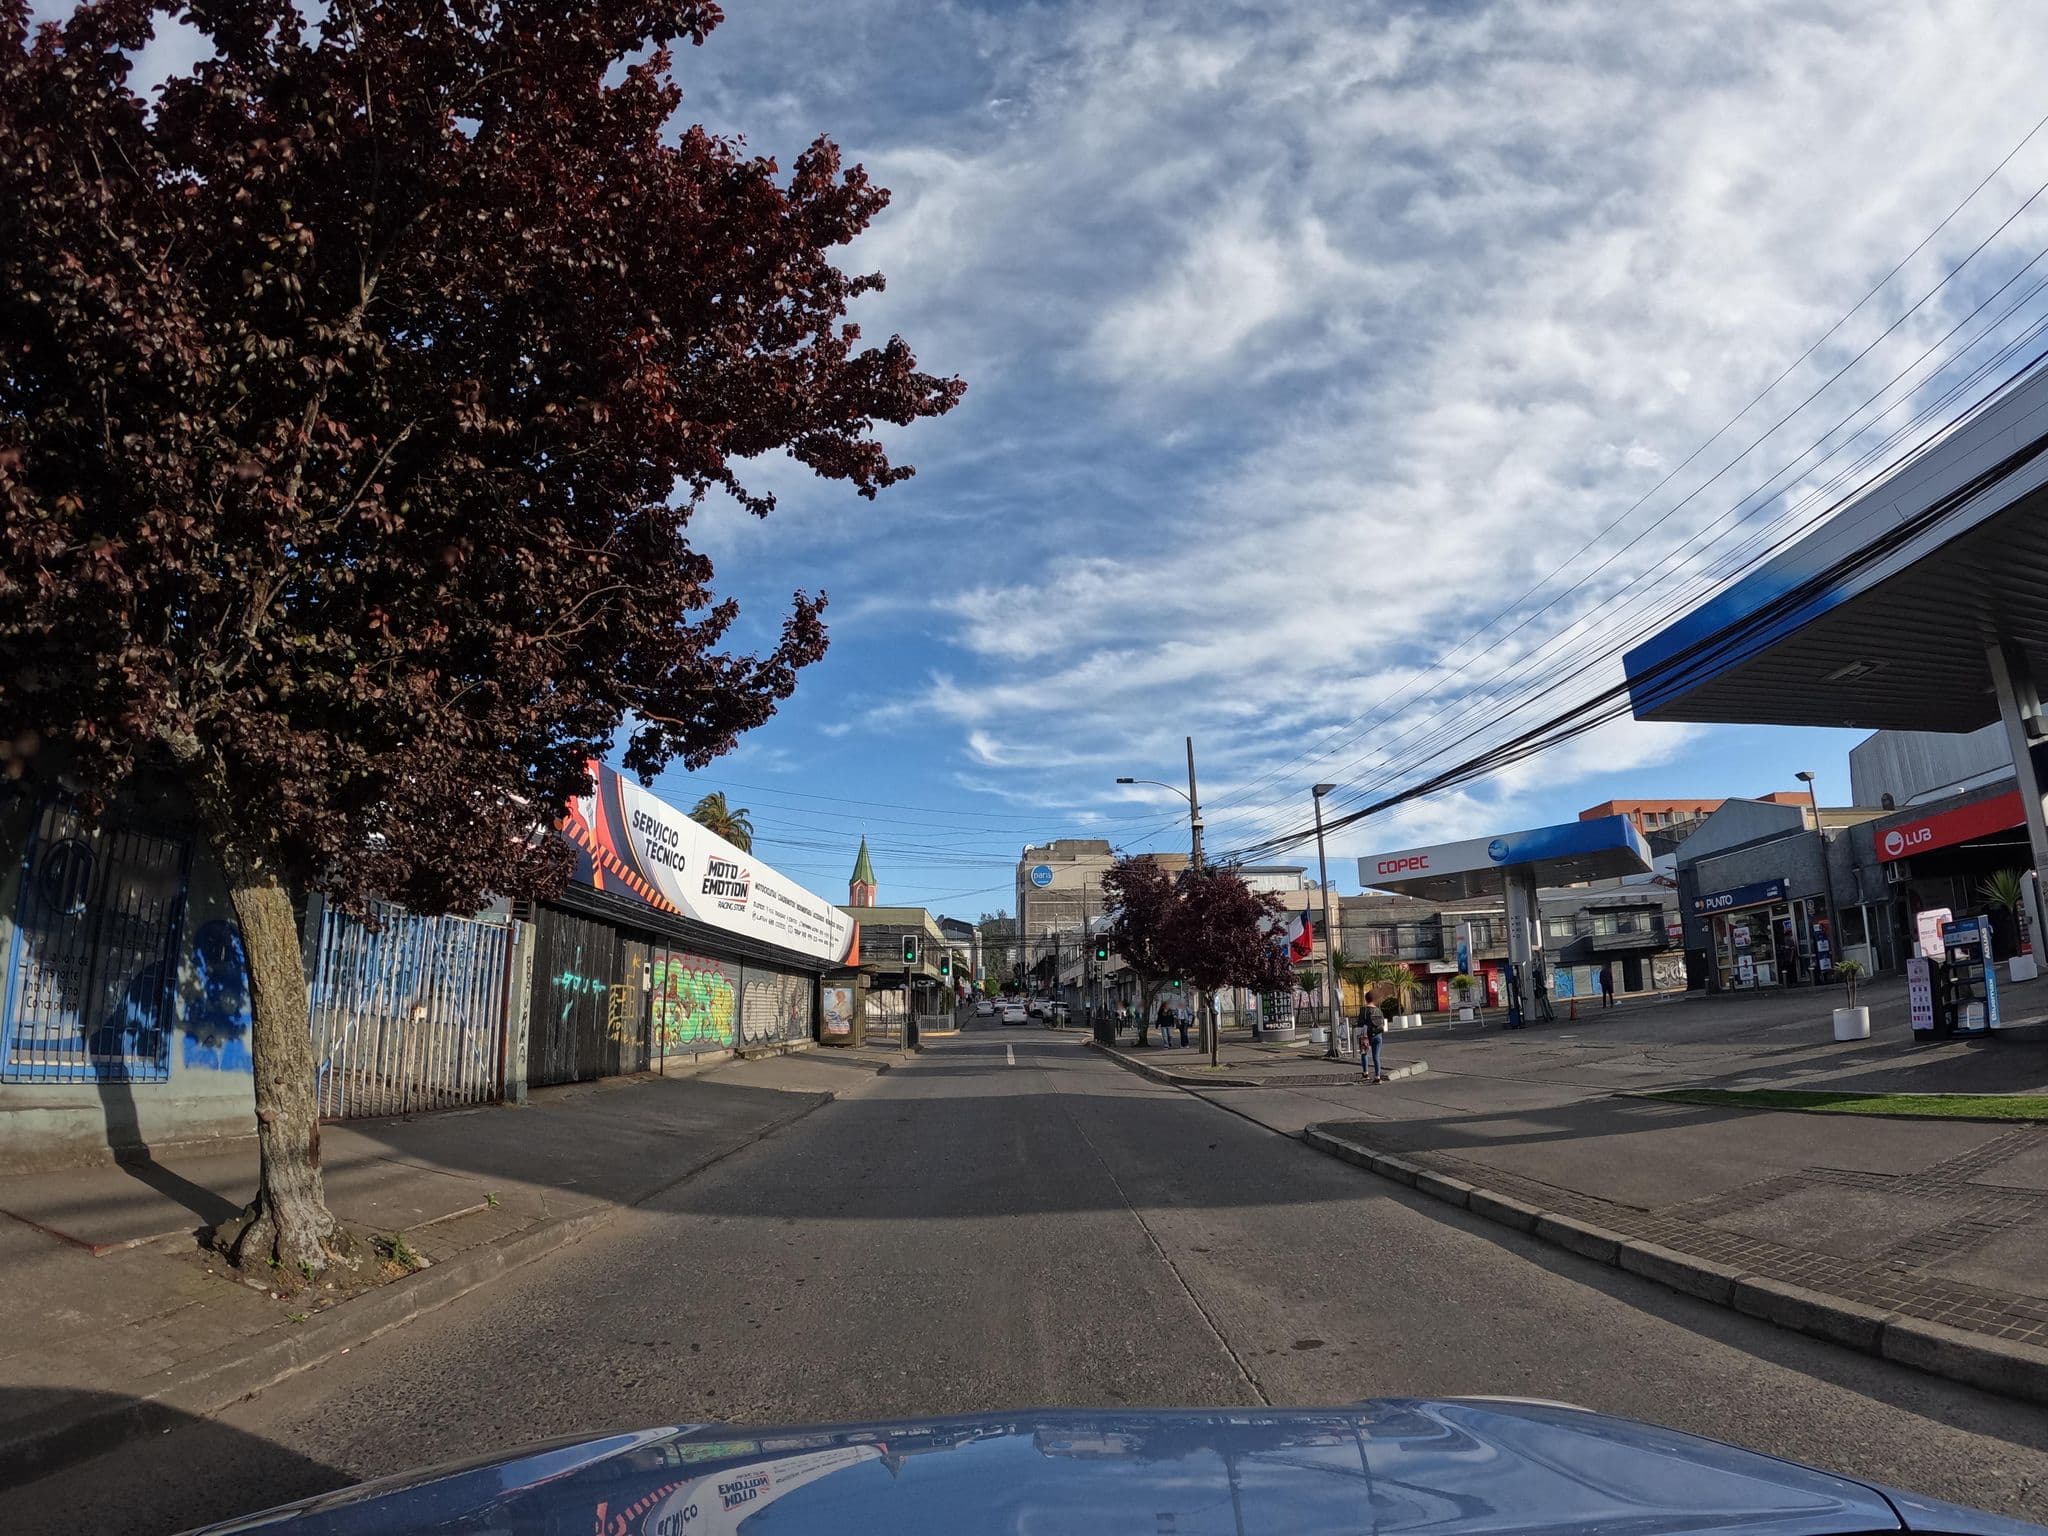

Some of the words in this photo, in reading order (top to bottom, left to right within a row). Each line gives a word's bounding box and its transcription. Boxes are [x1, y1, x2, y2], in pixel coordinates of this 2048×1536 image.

[632, 809, 679, 848] SERVICIO
[1905, 828, 1932, 846] LUB
[645, 837, 686, 872] TÉCNICO
[708, 861, 738, 880] MOTO
[1378, 856, 1429, 875] COPEC
[702, 878, 749, 898] EMOTION
[1706, 894, 1733, 909] PUNTO
